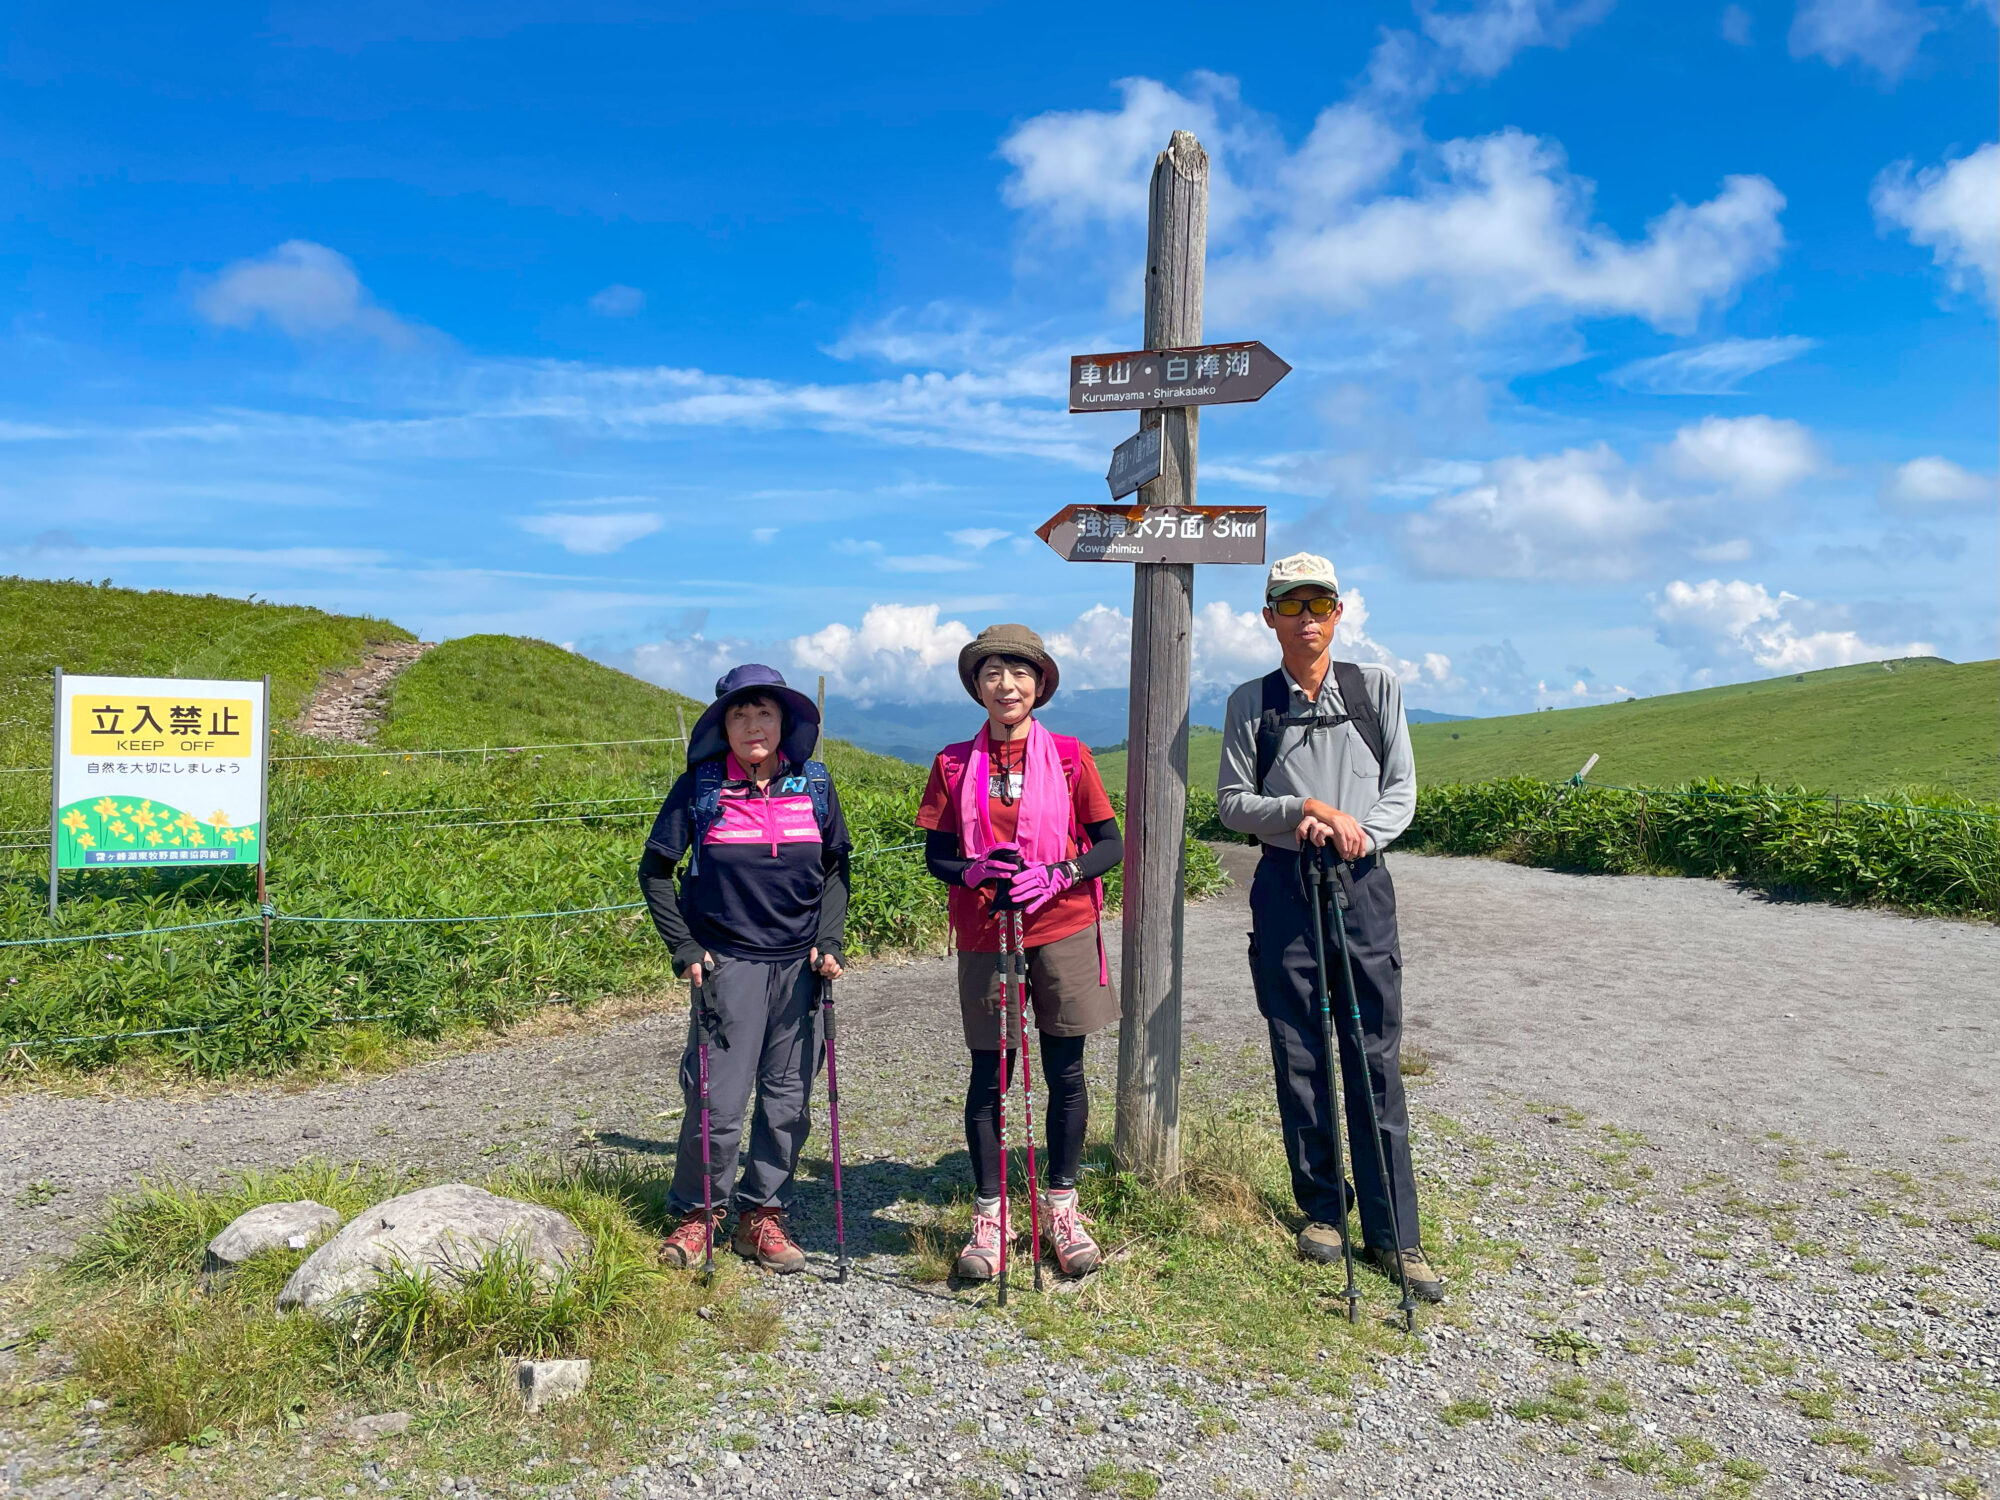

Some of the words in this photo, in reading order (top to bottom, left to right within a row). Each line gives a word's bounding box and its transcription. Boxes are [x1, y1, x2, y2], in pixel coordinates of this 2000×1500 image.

[1082, 392, 1145, 403] Kurumayama
[1153, 385, 1216, 399] Shirakabako
[1212, 515, 1256, 538] 3km
[1077, 542, 1144, 554] Kowashimizu
[91, 705, 239, 736] 立入禁止
[117, 740, 164, 751] KEEP
[180, 741, 215, 752] OFF
[87, 762, 240, 774] 自然を大切にしましょう
